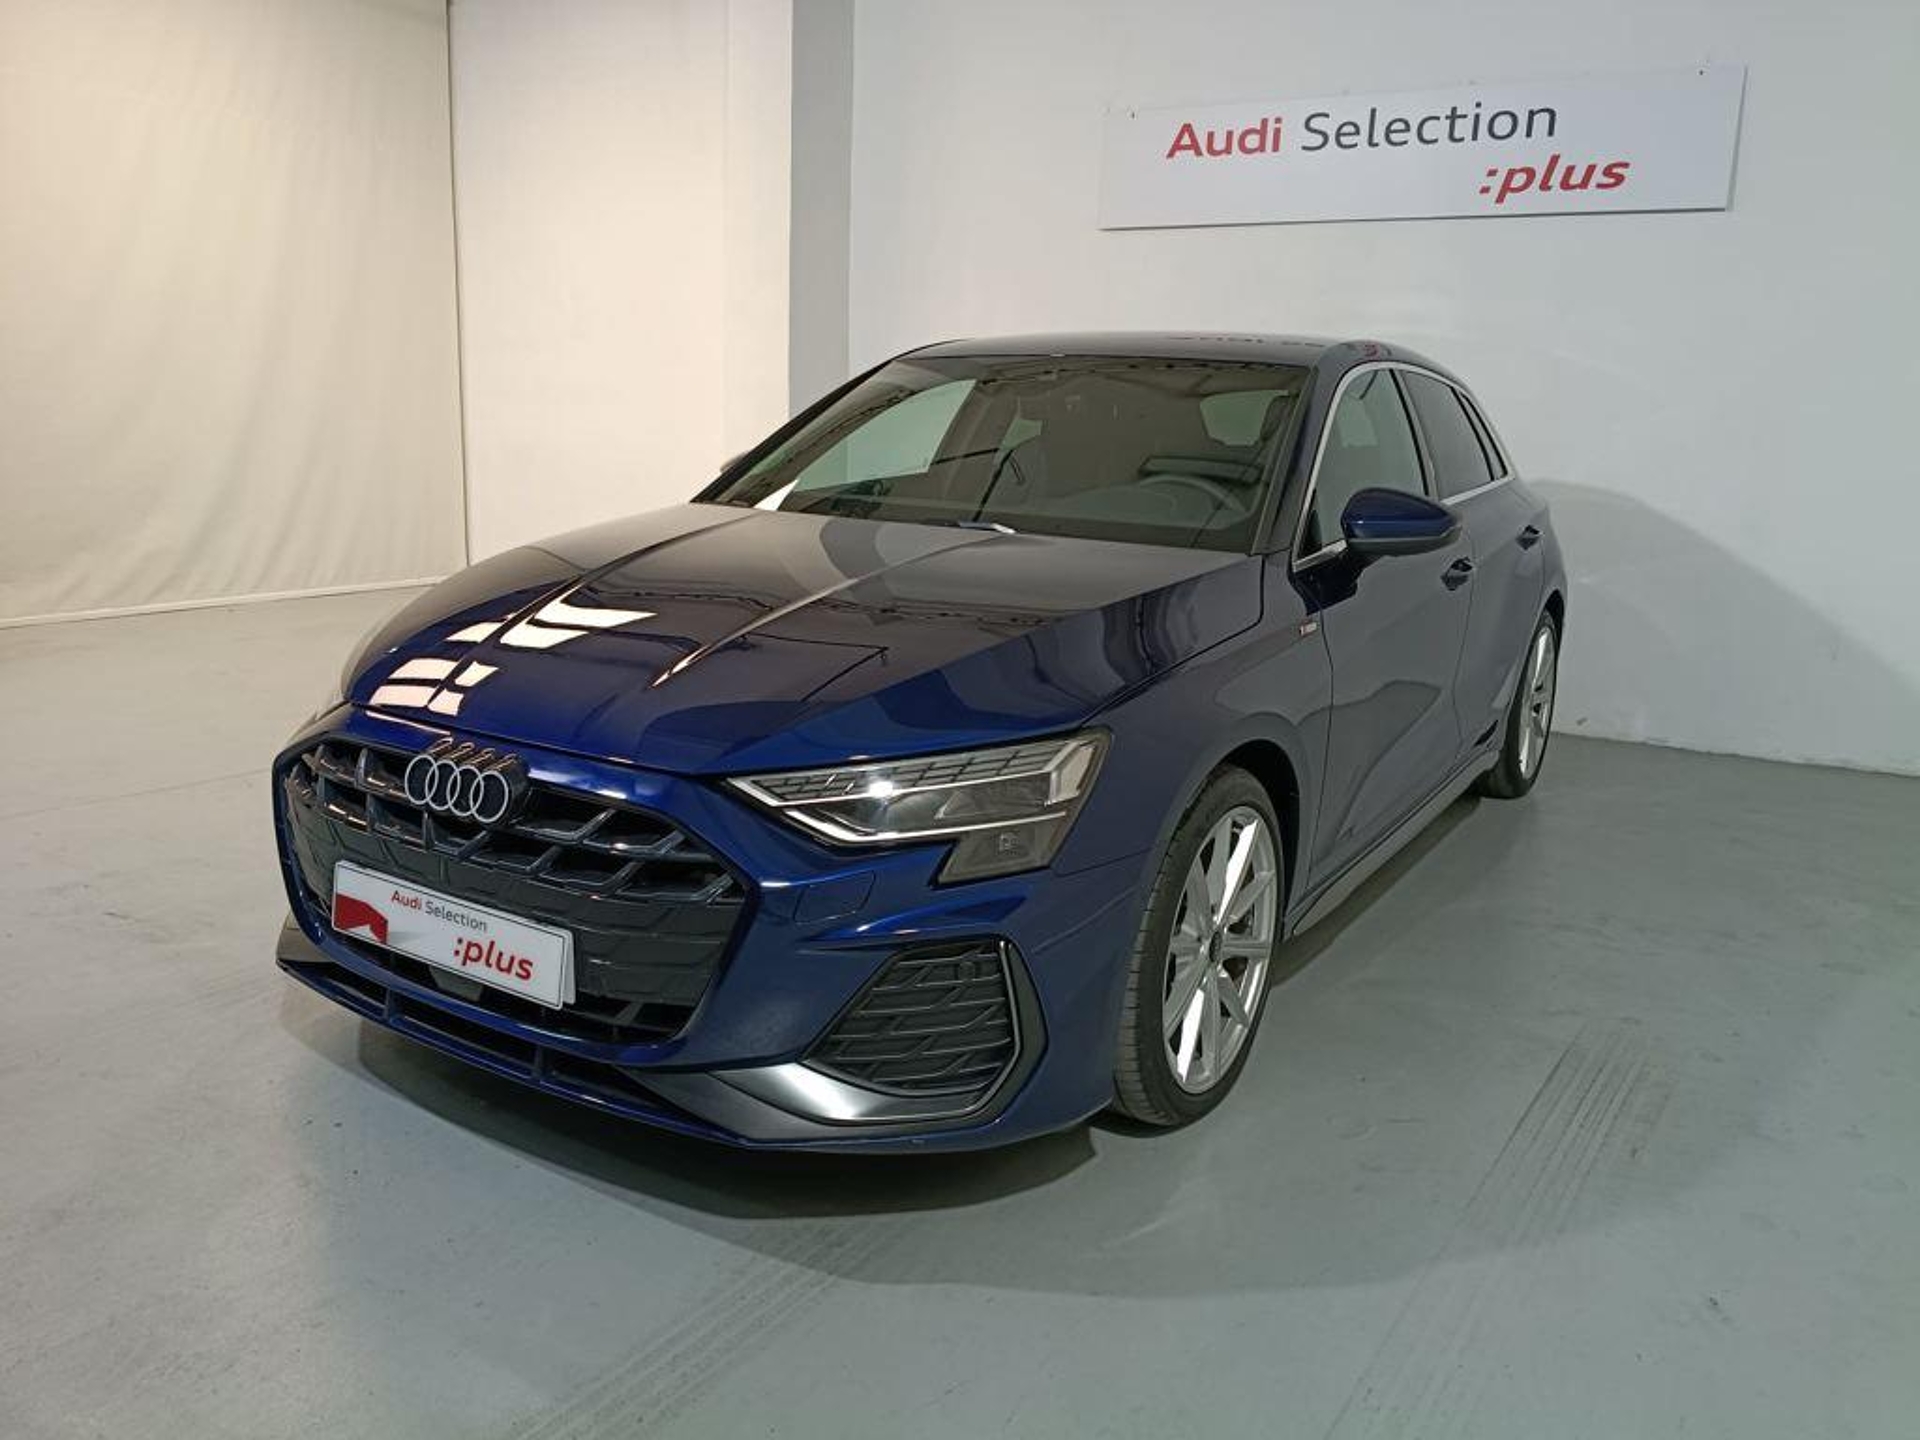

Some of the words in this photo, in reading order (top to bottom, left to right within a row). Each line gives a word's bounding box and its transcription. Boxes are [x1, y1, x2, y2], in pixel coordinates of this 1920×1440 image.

[1165, 116, 1283, 159] Audi
[1301, 101, 1558, 152] Selection
[1478, 153, 1631, 204] :plus
[390, 890, 423, 910] Audi
[425, 901, 488, 932] Selection
[453, 936, 534, 981] :plus
